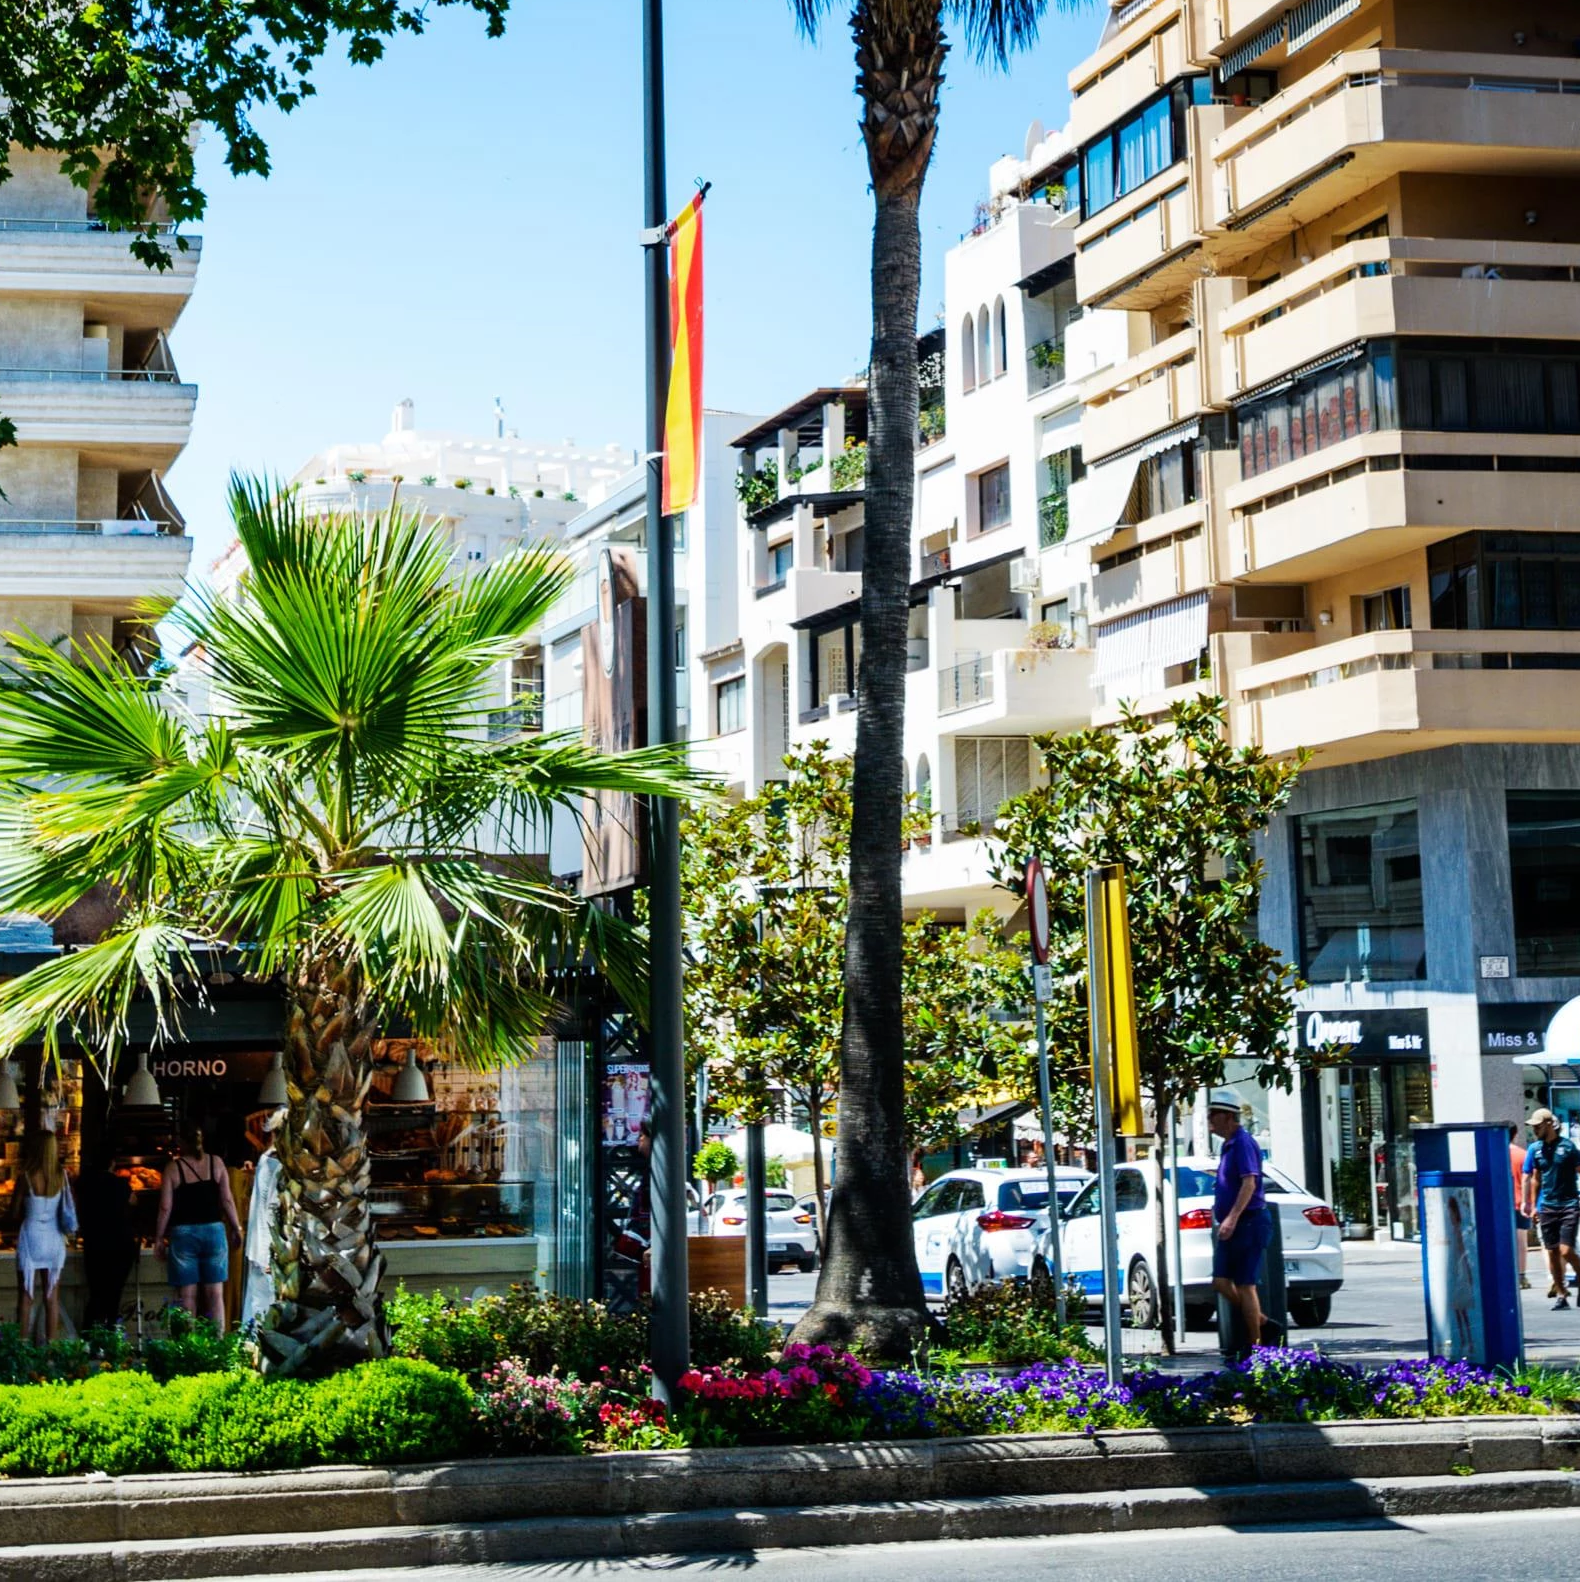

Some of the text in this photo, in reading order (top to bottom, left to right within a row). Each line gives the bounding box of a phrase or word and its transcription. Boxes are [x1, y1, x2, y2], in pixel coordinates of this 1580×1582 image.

[1306, 1011, 1364, 1052] Queen
[1488, 1032, 1522, 1047] Miss
[1527, 1031, 1538, 1046] &
[153, 1060, 227, 1077] HORNO
